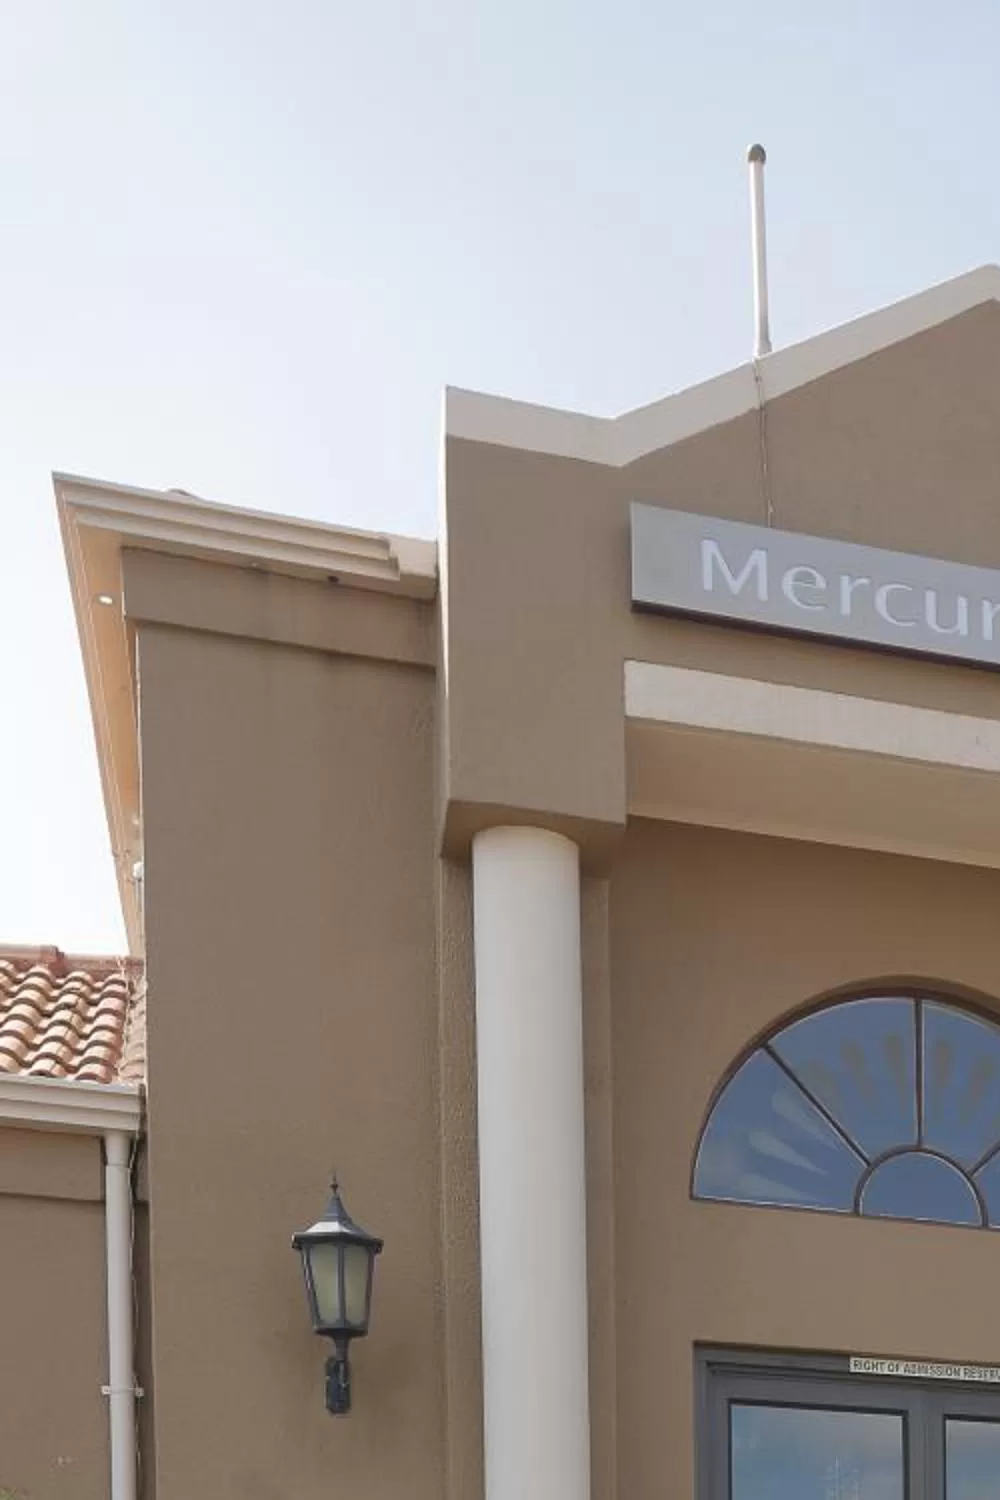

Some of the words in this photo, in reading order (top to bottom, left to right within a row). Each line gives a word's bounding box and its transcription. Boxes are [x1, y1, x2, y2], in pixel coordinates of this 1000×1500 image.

[853, 1359, 885, 1373] RIGHT
[887, 1361, 900, 1374] OF
[903, 1362, 962, 1378] ADMISSION
